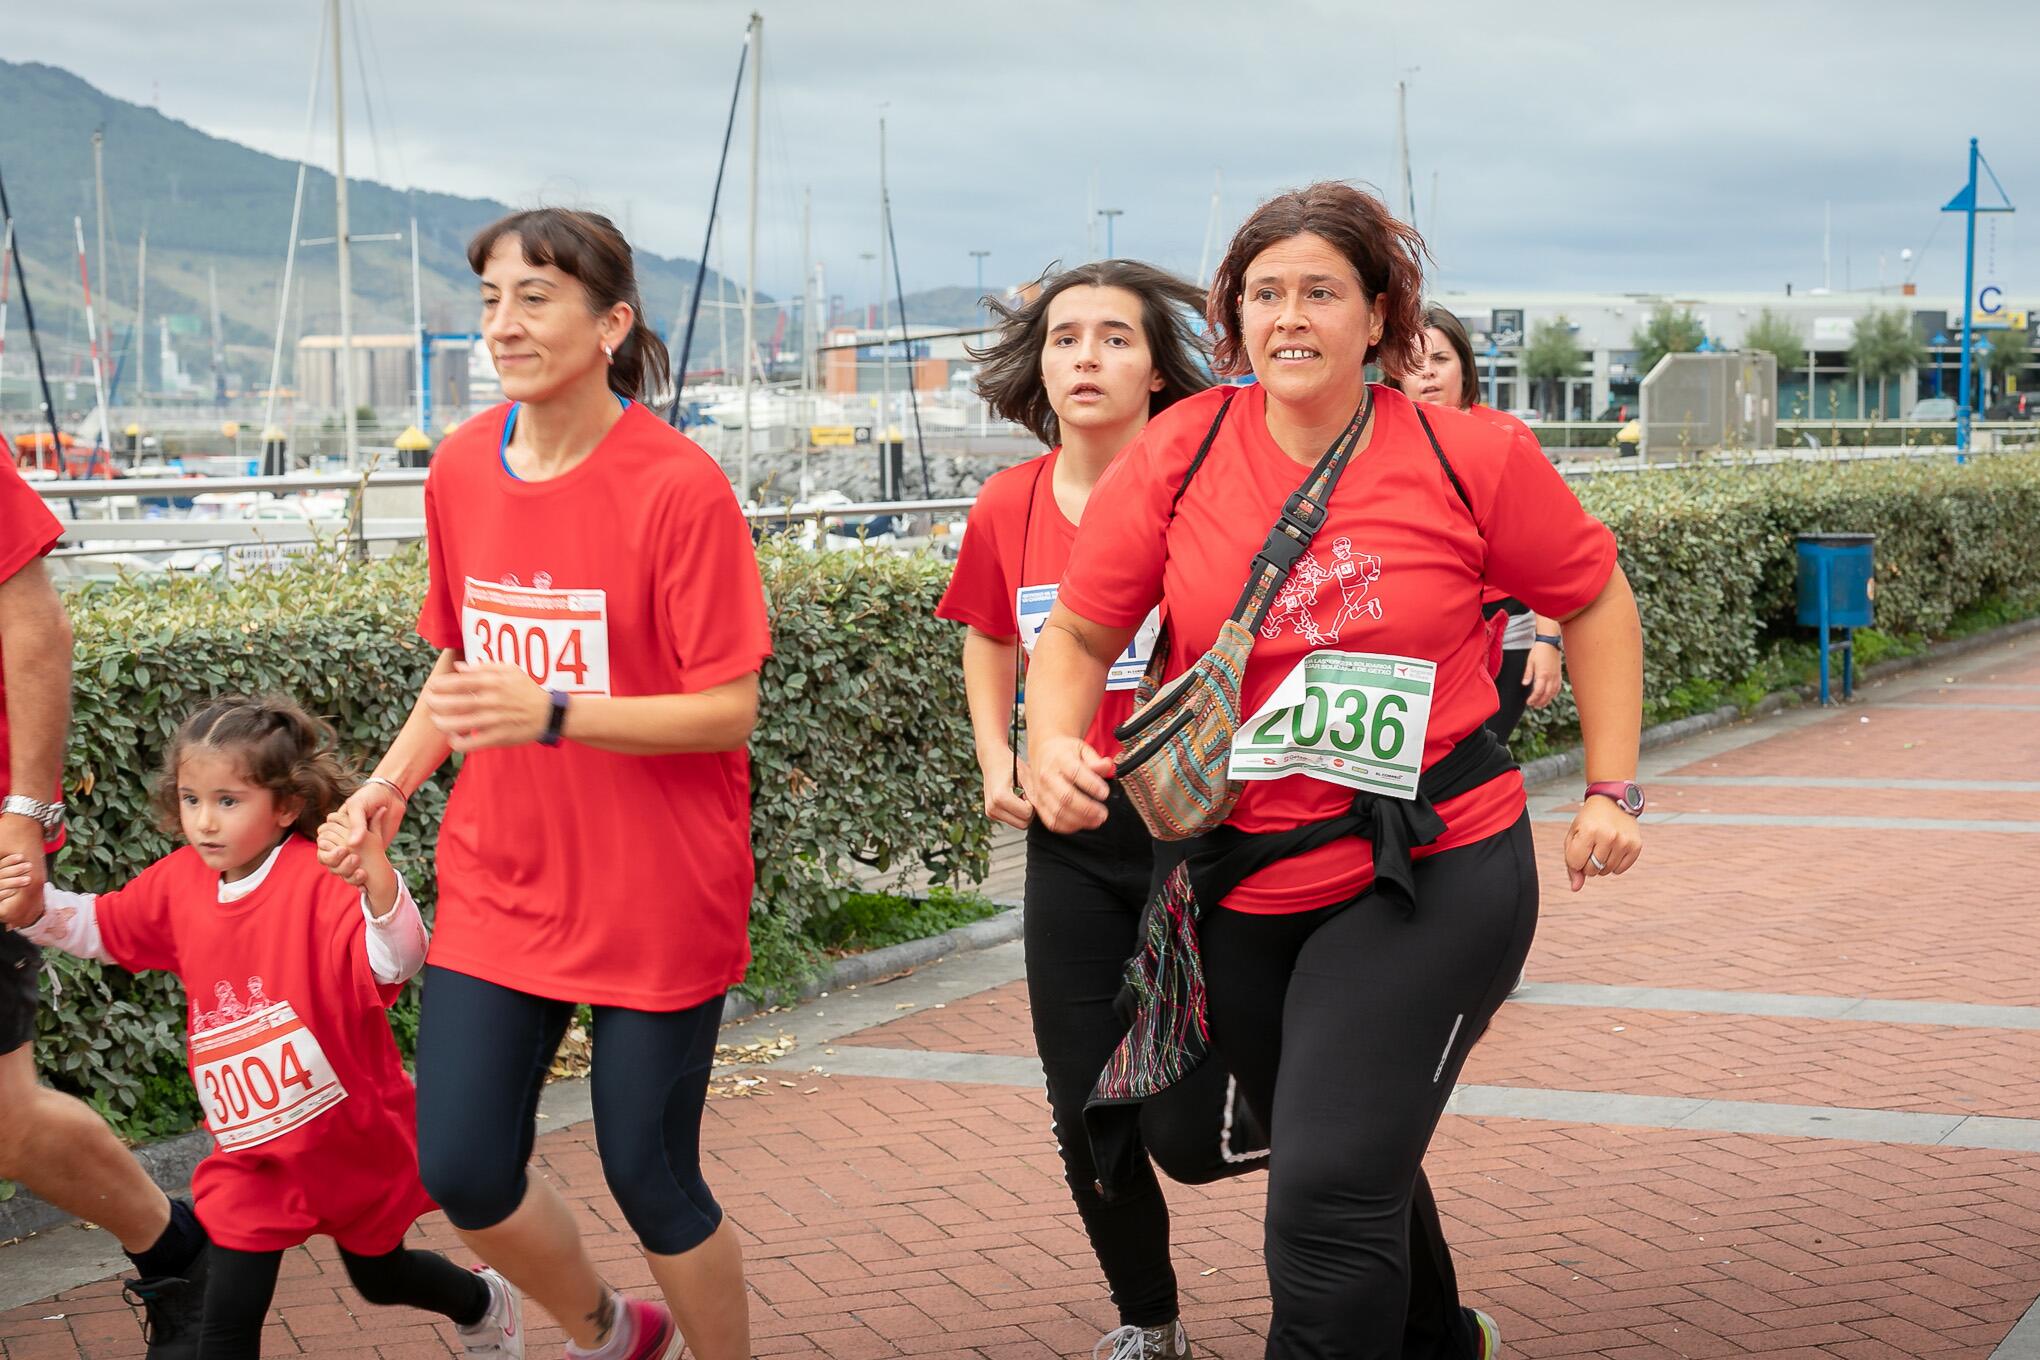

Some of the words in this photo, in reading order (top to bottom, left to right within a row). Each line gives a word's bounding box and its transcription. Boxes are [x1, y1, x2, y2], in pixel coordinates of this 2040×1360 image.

[1979, 286, 2002, 314] C
[475, 618, 588, 685] 3004
[205, 1040, 313, 1125] 3004
